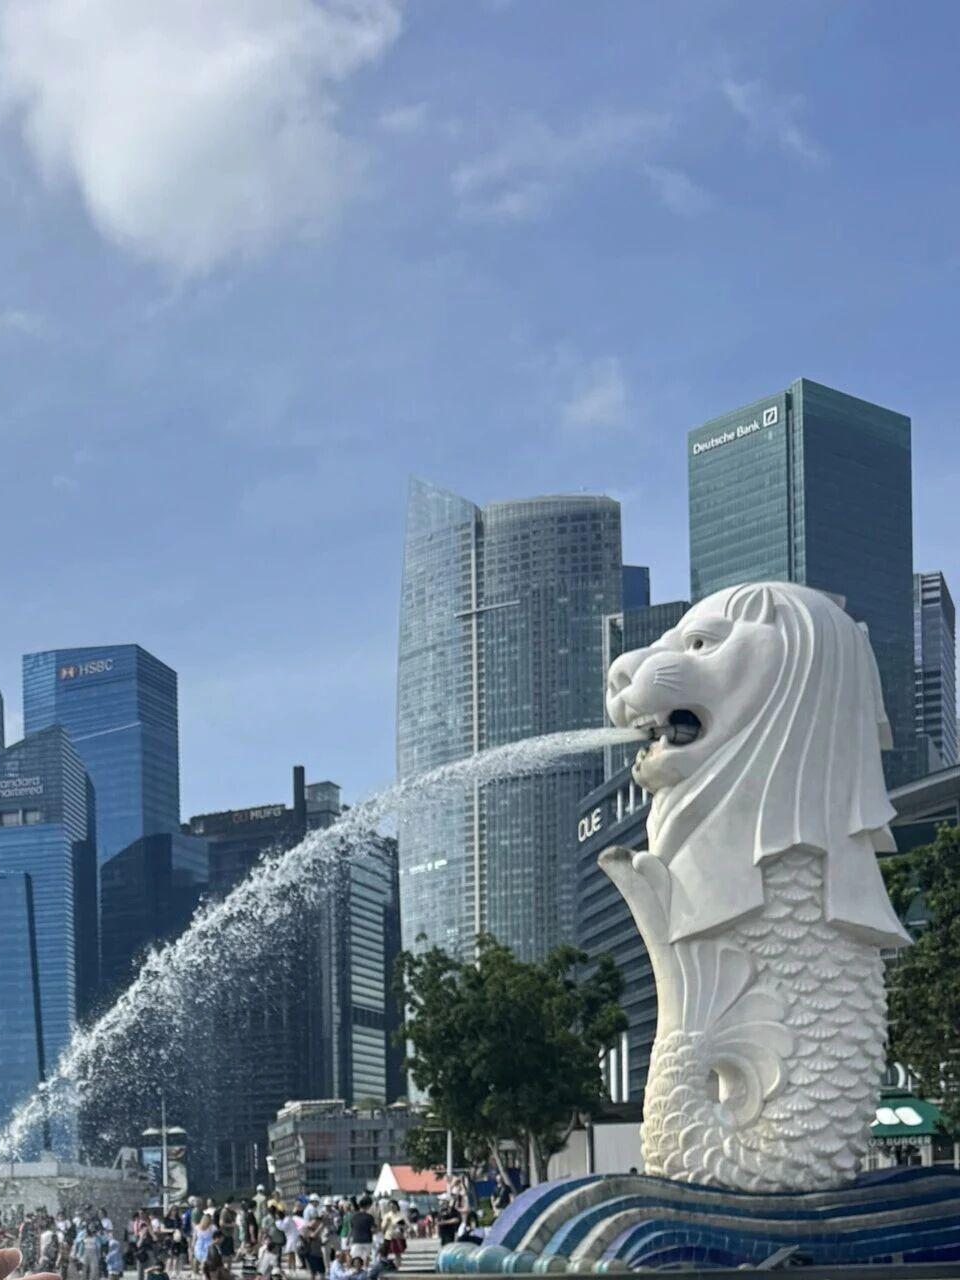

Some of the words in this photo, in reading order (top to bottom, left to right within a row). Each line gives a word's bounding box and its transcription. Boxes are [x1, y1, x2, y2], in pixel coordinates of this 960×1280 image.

[692, 431, 736, 455] Deutsche
[737, 420, 760, 438] Bank
[80, 658, 114, 676] HSBC
[578, 807, 602, 842] OUE
